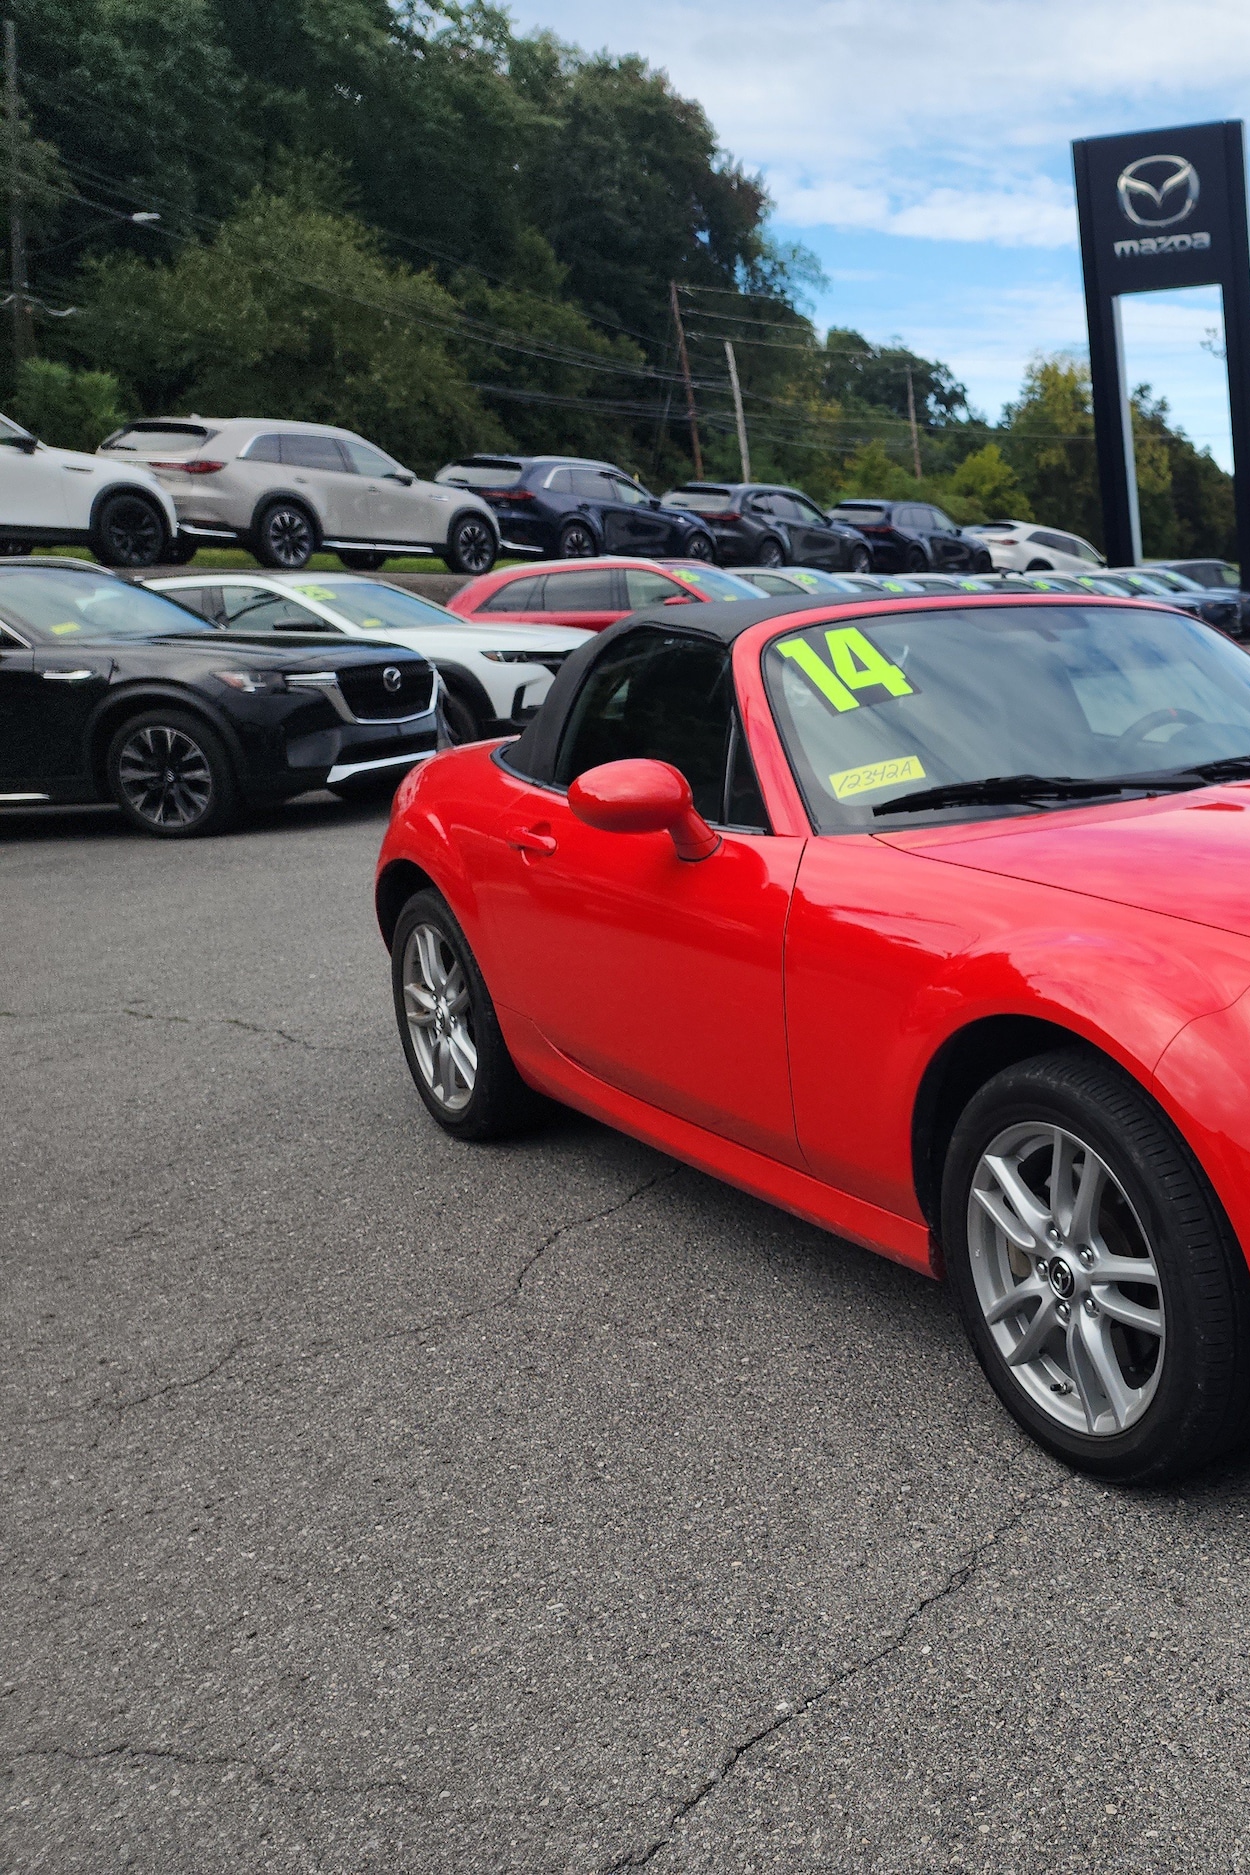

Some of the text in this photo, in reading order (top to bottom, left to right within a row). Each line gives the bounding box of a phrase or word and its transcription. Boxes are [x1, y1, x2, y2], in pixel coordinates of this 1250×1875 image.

[1113, 232, 1211, 257] mazda
[776, 627, 913, 712] 14
[838, 762, 913, 793] 12342A
